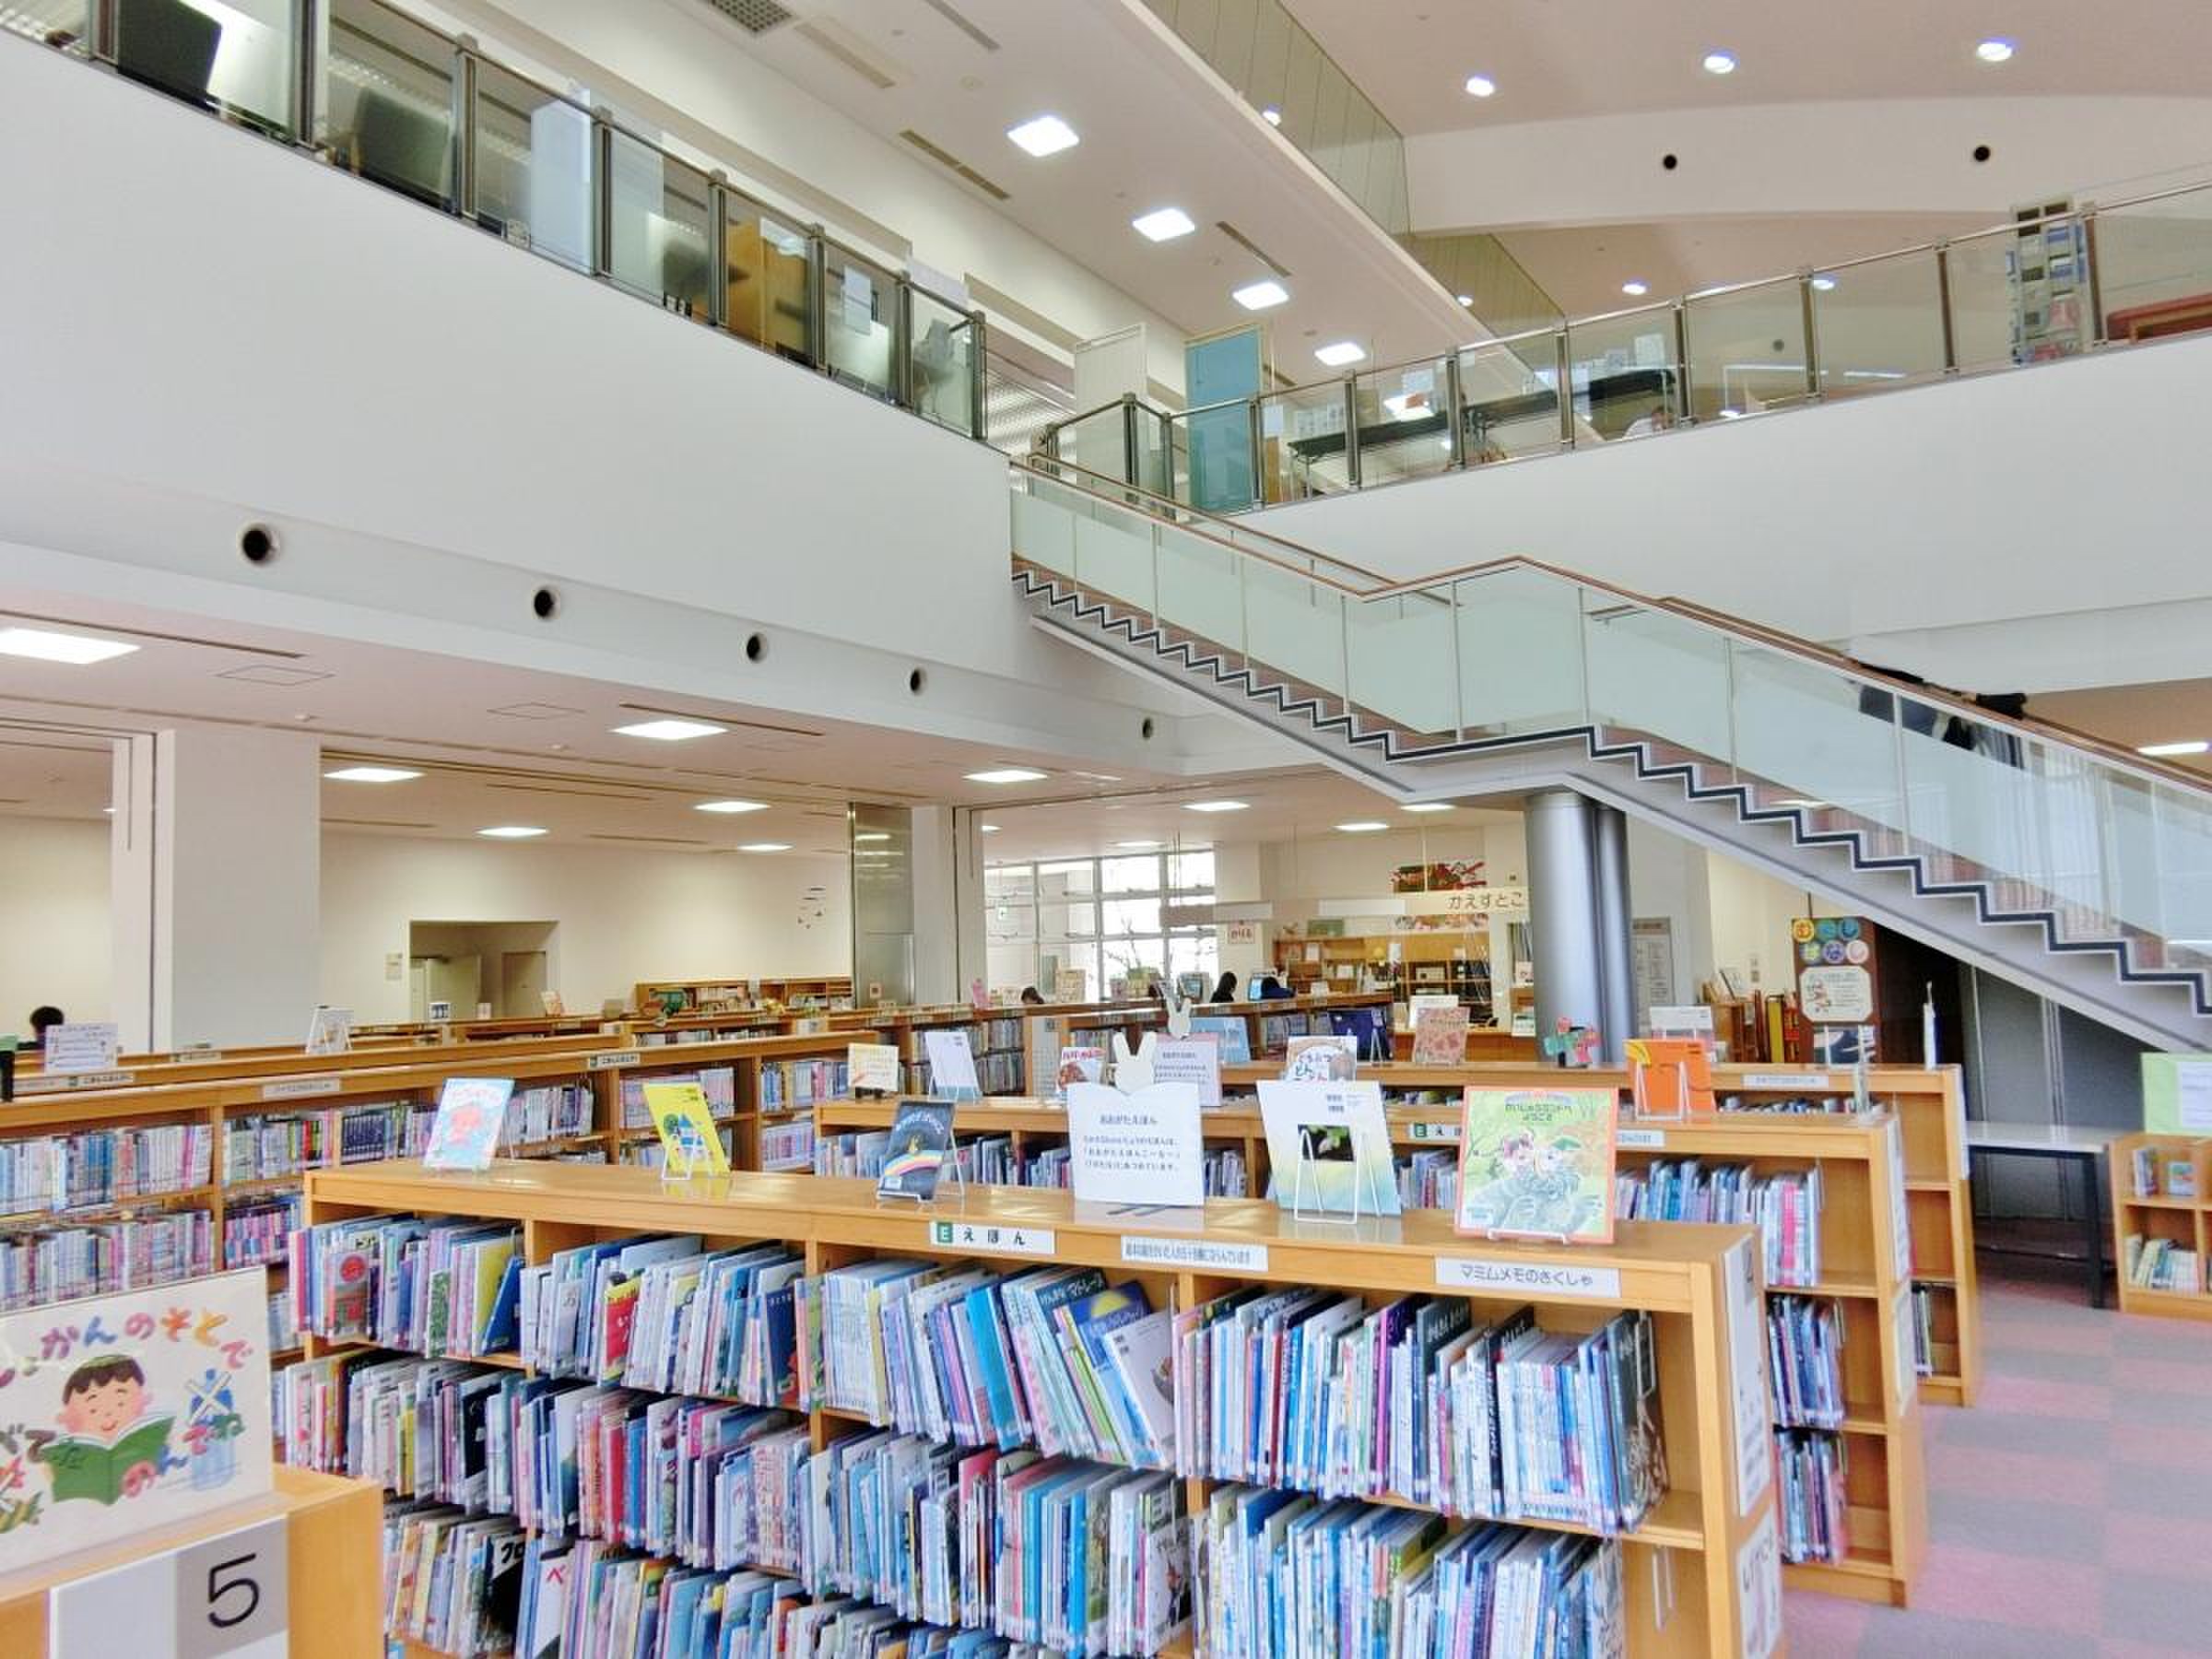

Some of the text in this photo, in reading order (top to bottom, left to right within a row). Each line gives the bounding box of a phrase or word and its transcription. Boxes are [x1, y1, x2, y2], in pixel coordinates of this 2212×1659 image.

[963, 1226, 1026, 1246] えほん
[1460, 1263, 1594, 1287] マミムメモのさくしゃ
[207, 1552, 260, 1629] 5
